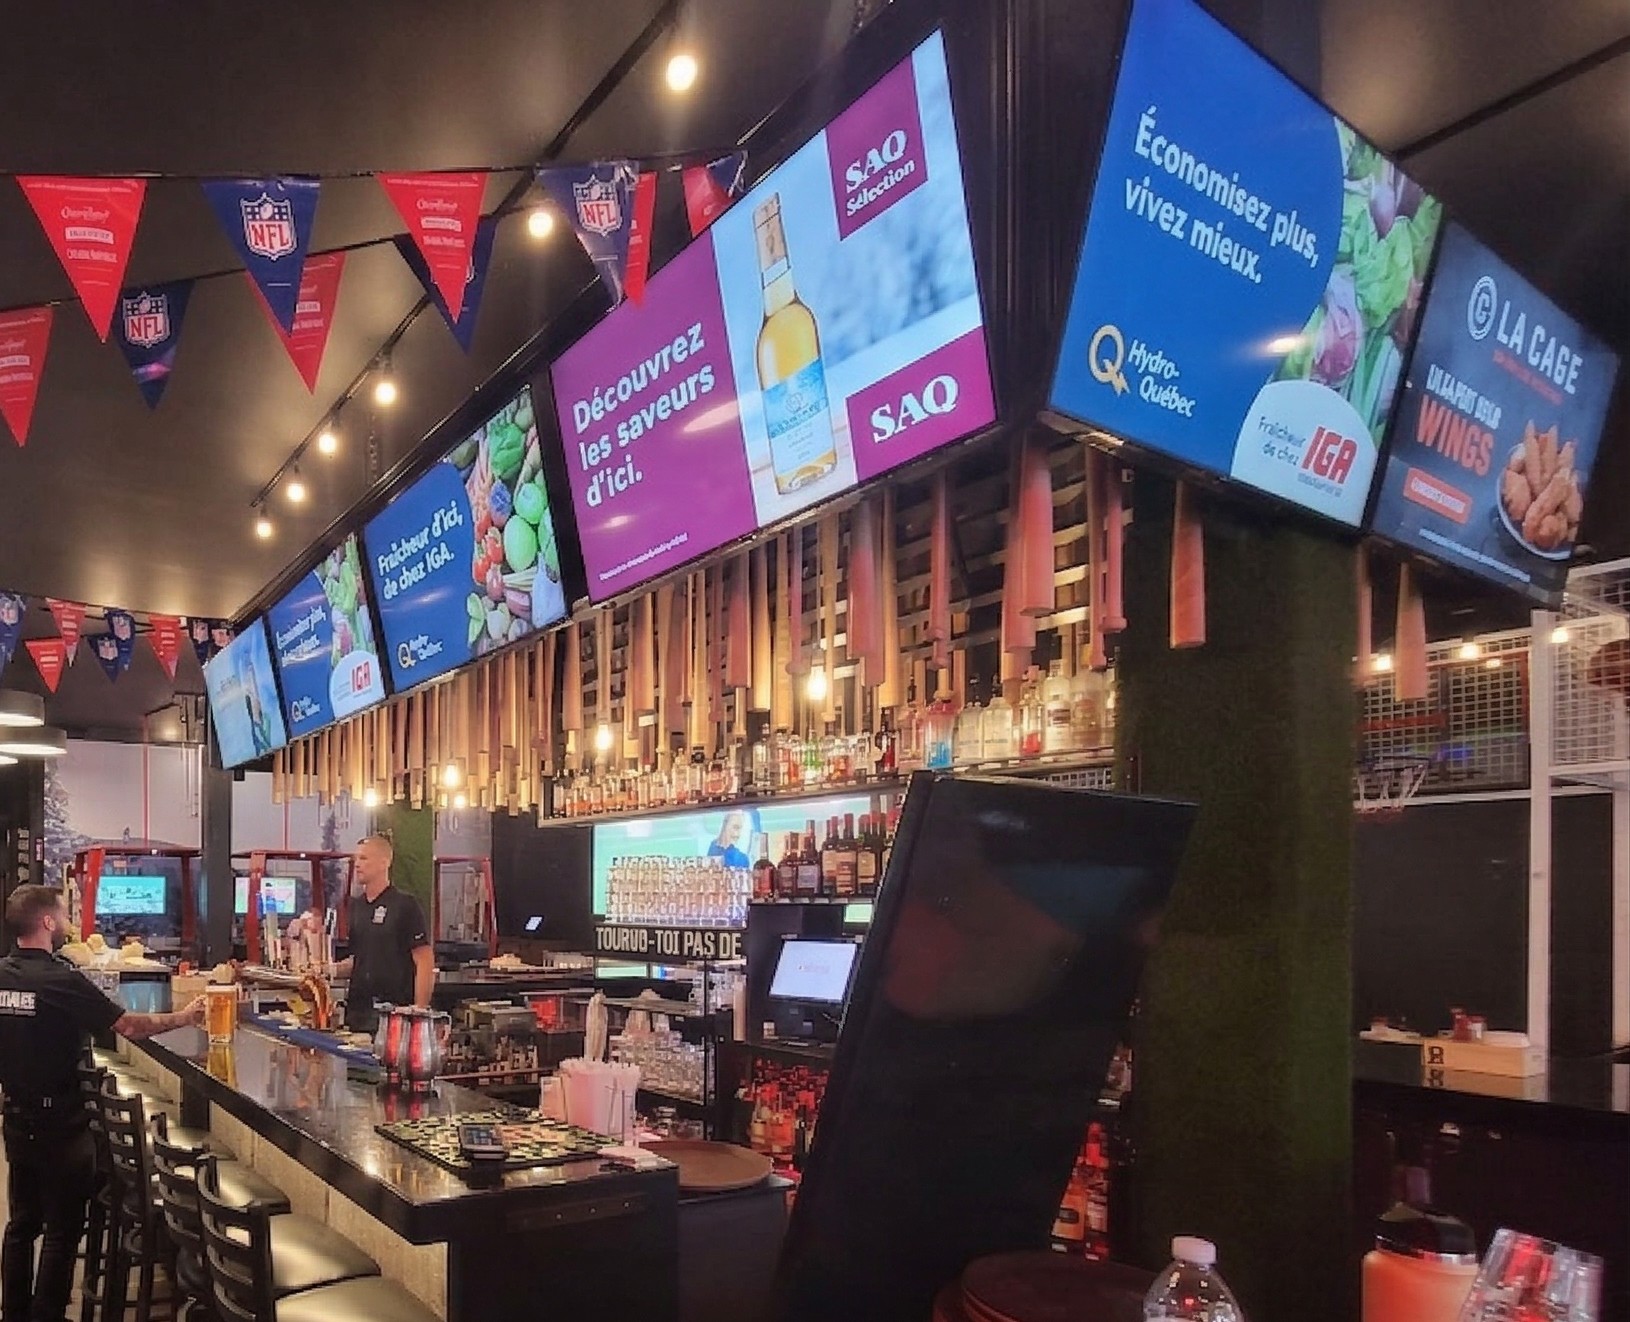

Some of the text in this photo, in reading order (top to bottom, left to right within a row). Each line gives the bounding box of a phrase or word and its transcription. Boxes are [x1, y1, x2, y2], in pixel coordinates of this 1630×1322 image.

[845, 129, 908, 194] SAQ
[1135, 105, 1320, 269] Économisez plus,
[251, 223, 290, 250] NFL
[582, 202, 616, 227] NFL
[1125, 175, 1262, 284] vivez mieux.
[130, 316, 163, 339] NFL
[1496, 299, 1527, 356] LA
[1528, 324, 1584, 395] CAGE
[572, 321, 705, 435] Découvrez
[1127, 338, 1180, 380] Hydro-
[578, 434, 613, 472] les
[617, 364, 716, 448] saveurs
[871, 374, 959, 444] SAQ
[1139, 374, 1197, 418] Québec
[1301, 425, 1358, 485] IGA
[1415, 393, 1496, 478] WINGS
[586, 453, 644, 509] d'ici.
[383, 577, 399, 600] de
[425, 541, 456, 574] IGA.
[351, 660, 372, 693] IGA
[682, 930, 716, 959] PAS
[718, 931, 743, 960] DE
